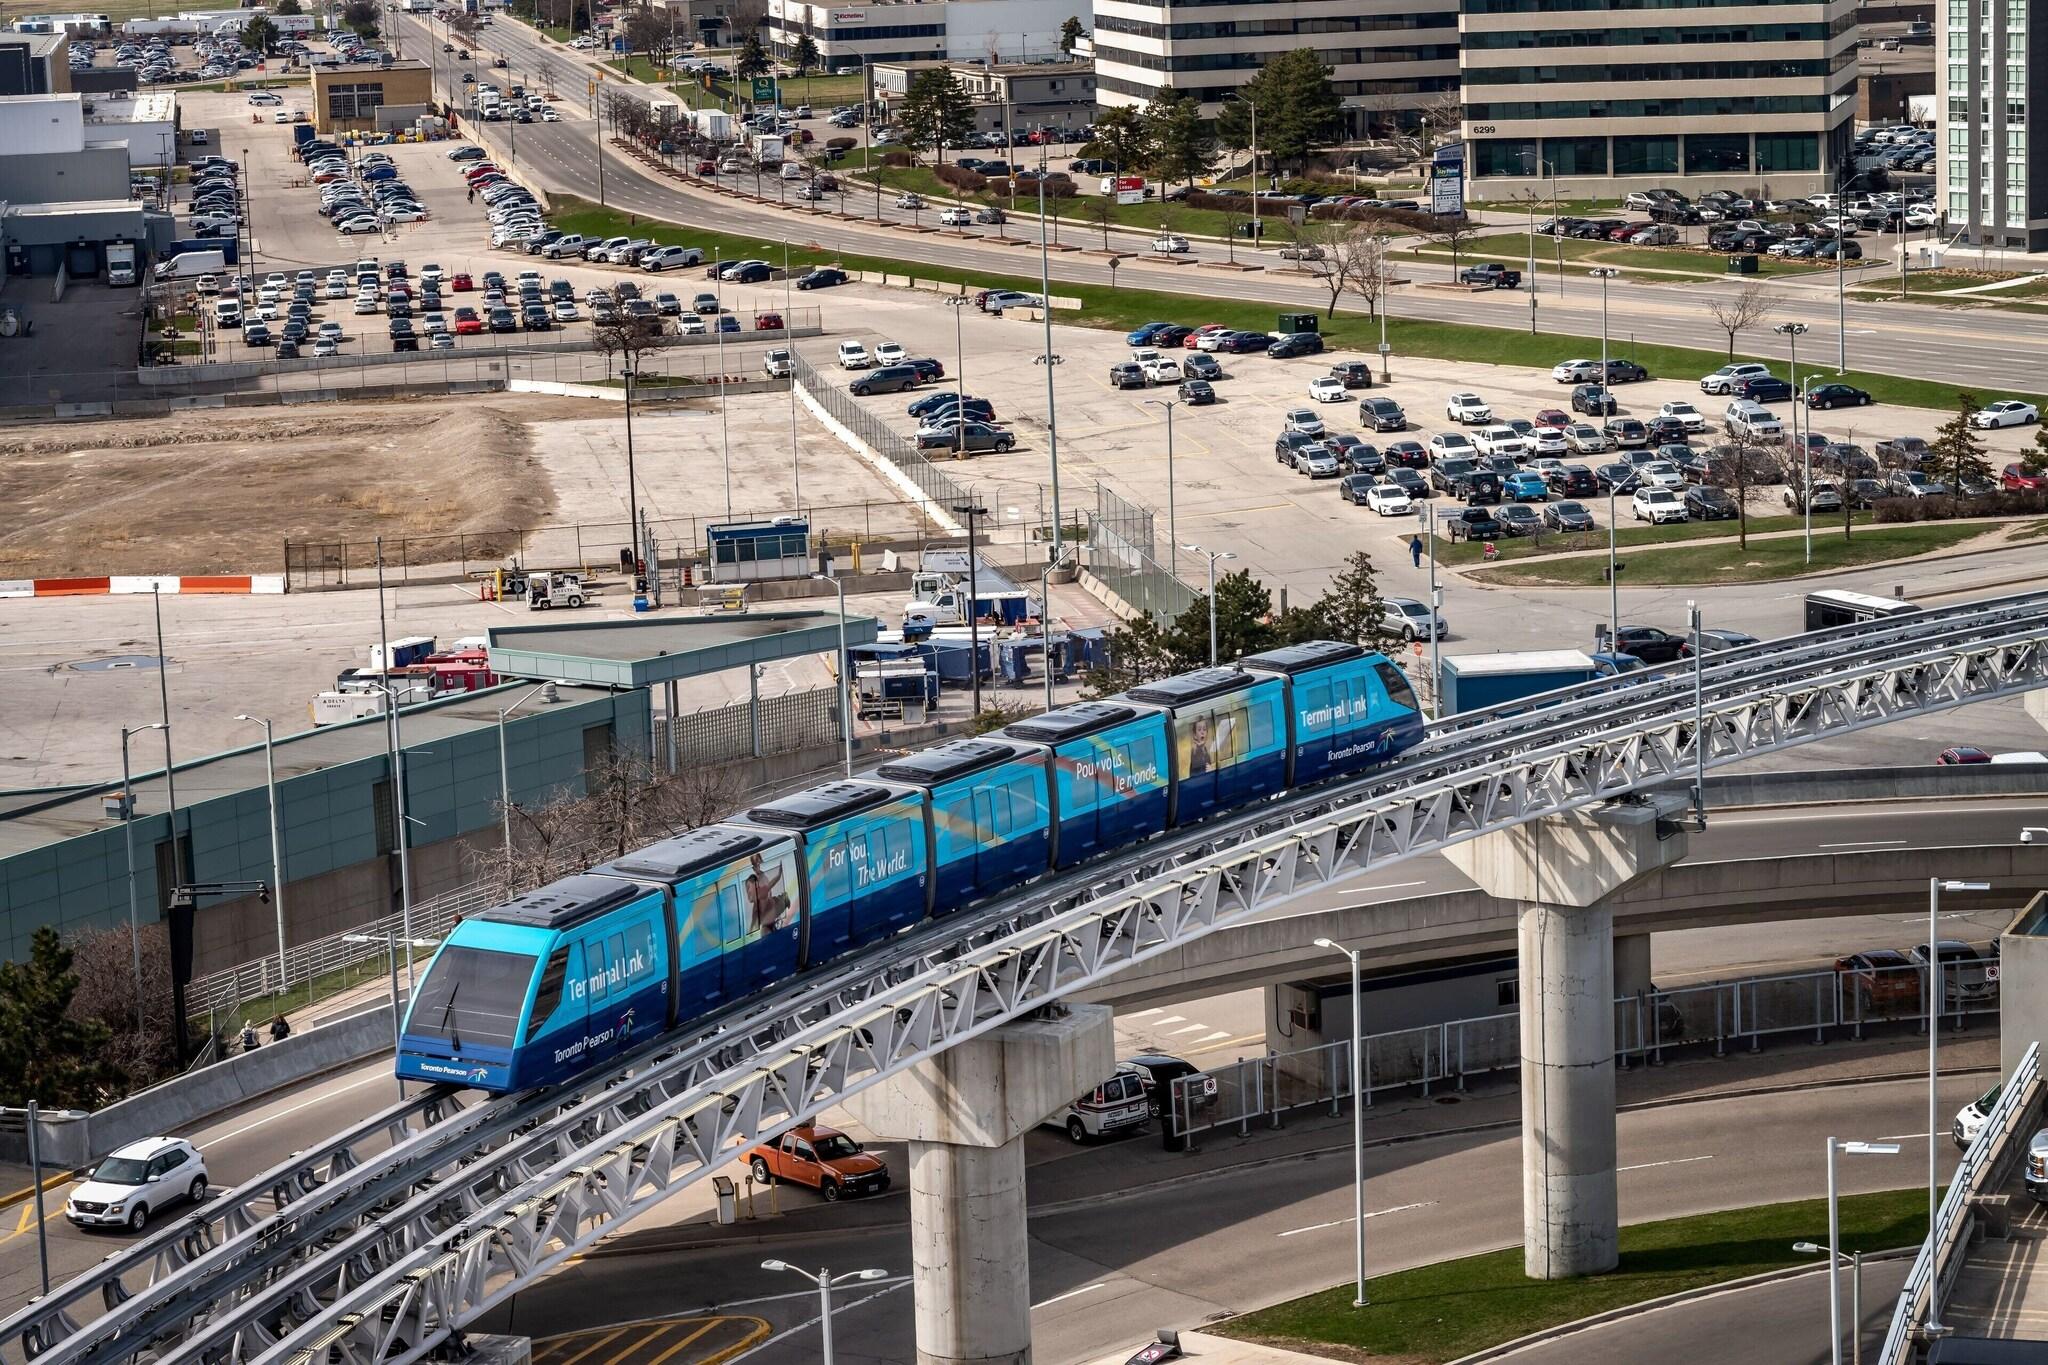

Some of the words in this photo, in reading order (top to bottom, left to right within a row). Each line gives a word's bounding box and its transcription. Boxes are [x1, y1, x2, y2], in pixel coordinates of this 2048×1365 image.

[1473, 125, 1496, 134] 6299
[1300, 699, 1346, 727] Terminal
[1327, 747, 1353, 762] Toronto
[1353, 740, 1375, 755] Pearson
[1076, 761, 1099, 780] Pour
[829, 848, 846, 869] For
[857, 864, 876, 886] The
[568, 959, 620, 1001] Terminal
[554, 1040, 583, 1063] Toronto
[583, 1028, 614, 1050] Pearson
[420, 1062, 443, 1073] Toronto
[443, 1066, 467, 1076] Pearson
